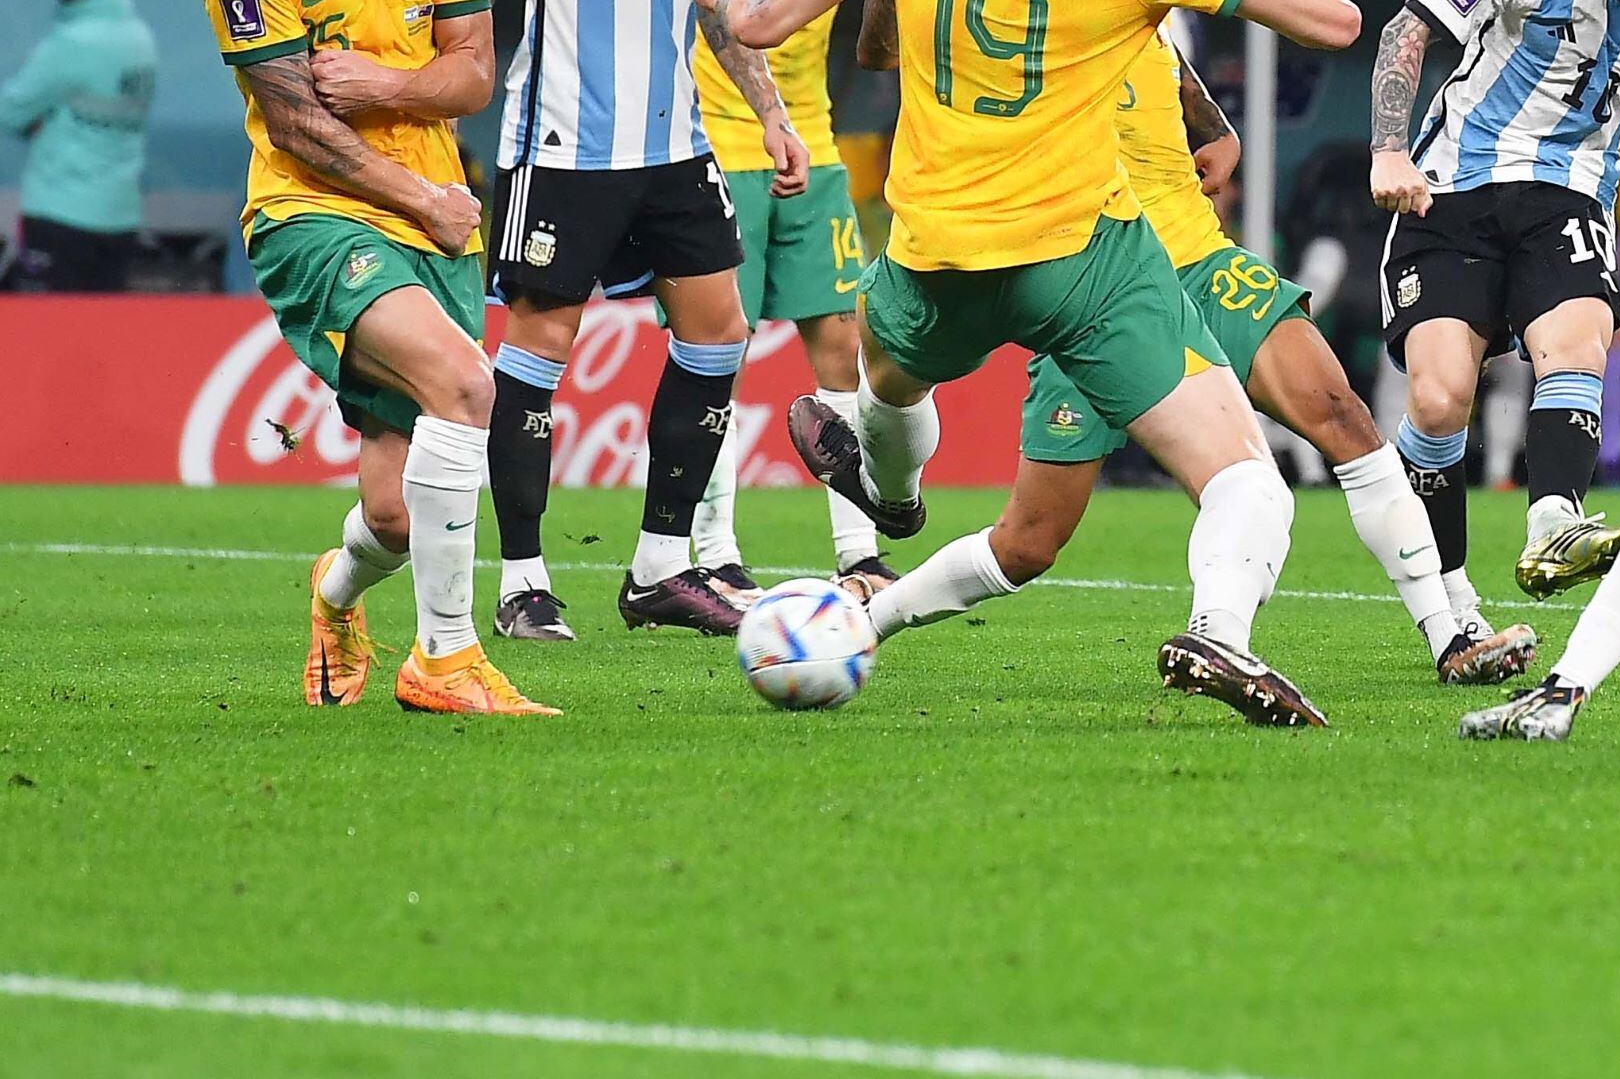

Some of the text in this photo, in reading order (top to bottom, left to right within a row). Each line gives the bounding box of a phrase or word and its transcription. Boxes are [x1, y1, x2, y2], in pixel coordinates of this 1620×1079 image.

[830, 217, 865, 271] 14
[1560, 218, 1617, 272] 10
[1210, 255, 1278, 321] 26
